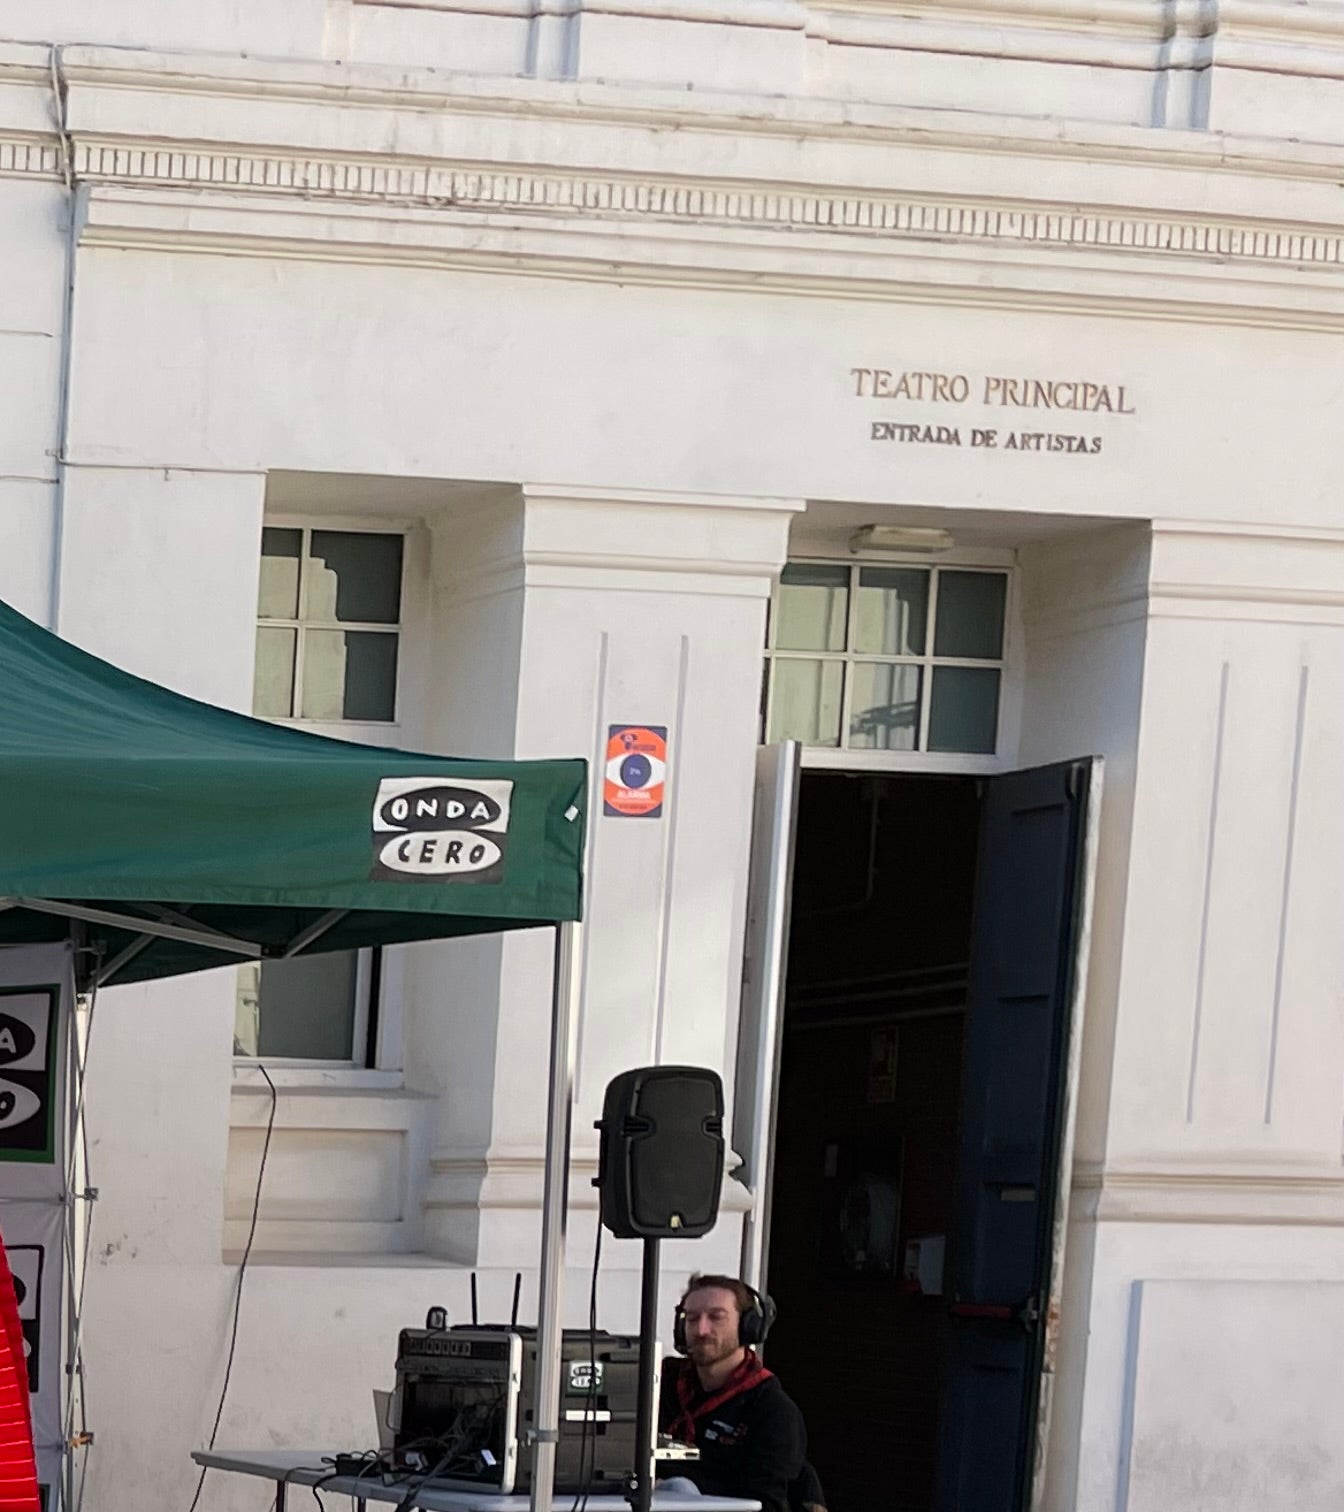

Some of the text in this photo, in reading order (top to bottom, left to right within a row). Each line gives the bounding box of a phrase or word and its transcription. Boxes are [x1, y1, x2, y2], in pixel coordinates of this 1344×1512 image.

[850, 368, 1136, 414] TEATRO PRINCIPAL
[870, 422, 1102, 454] ENTRADA DE ARTISTAS
[390, 798, 490, 821] ONDA
[397, 840, 485, 865] CERO
